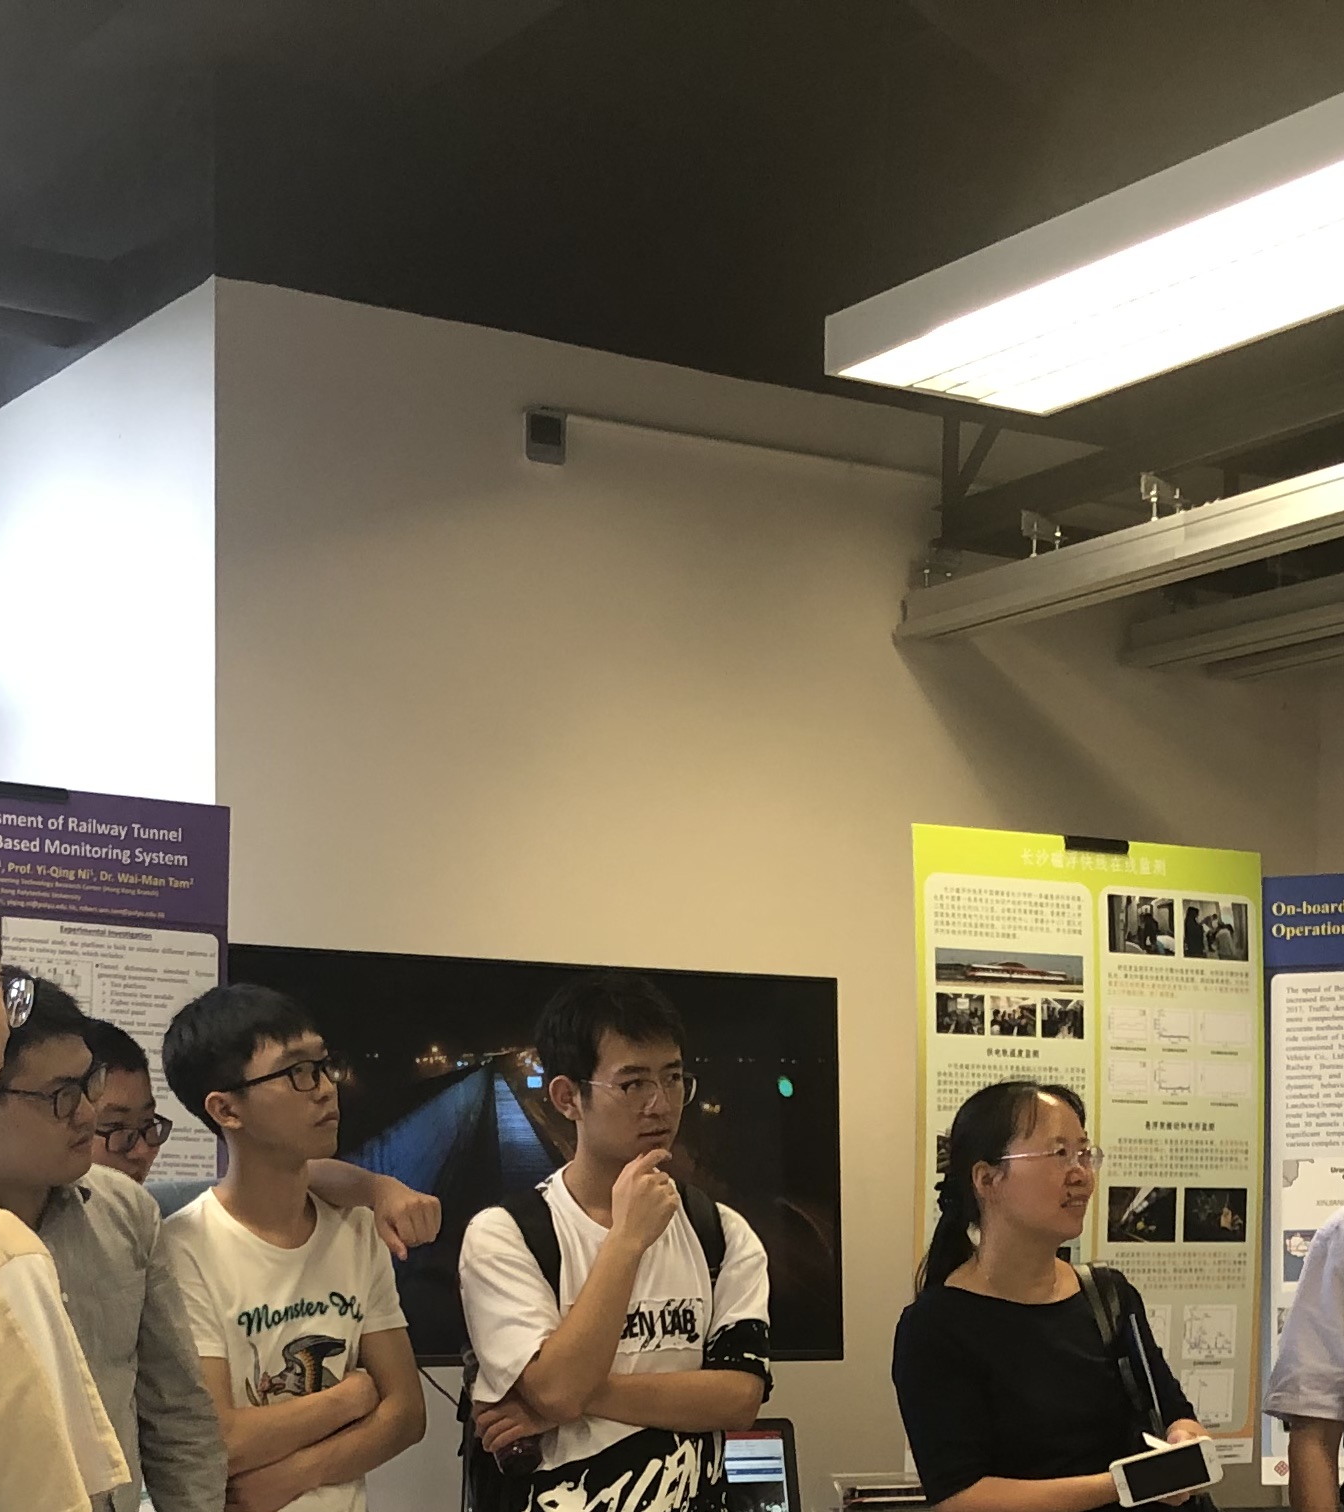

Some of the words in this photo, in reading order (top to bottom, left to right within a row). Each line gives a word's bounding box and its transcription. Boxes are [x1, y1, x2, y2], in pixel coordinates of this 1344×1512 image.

[48, 816, 64, 830] of
[69, 818, 127, 840] Railway
[132, 824, 182, 842] Tunnel
[45, 839, 130, 864] Monitoring
[135, 848, 188, 867] System
[37, 864, 75, 879] Yi-Qing
[100, 871, 115, 881] Dr.
[118, 873, 165, 887] Wai-Man
[60, 925, 106, 936] Experimental
[108, 928, 152, 940] Investigation
[238, 1298, 329, 1337] Monster
[660, 1309, 696, 1336] LAB
